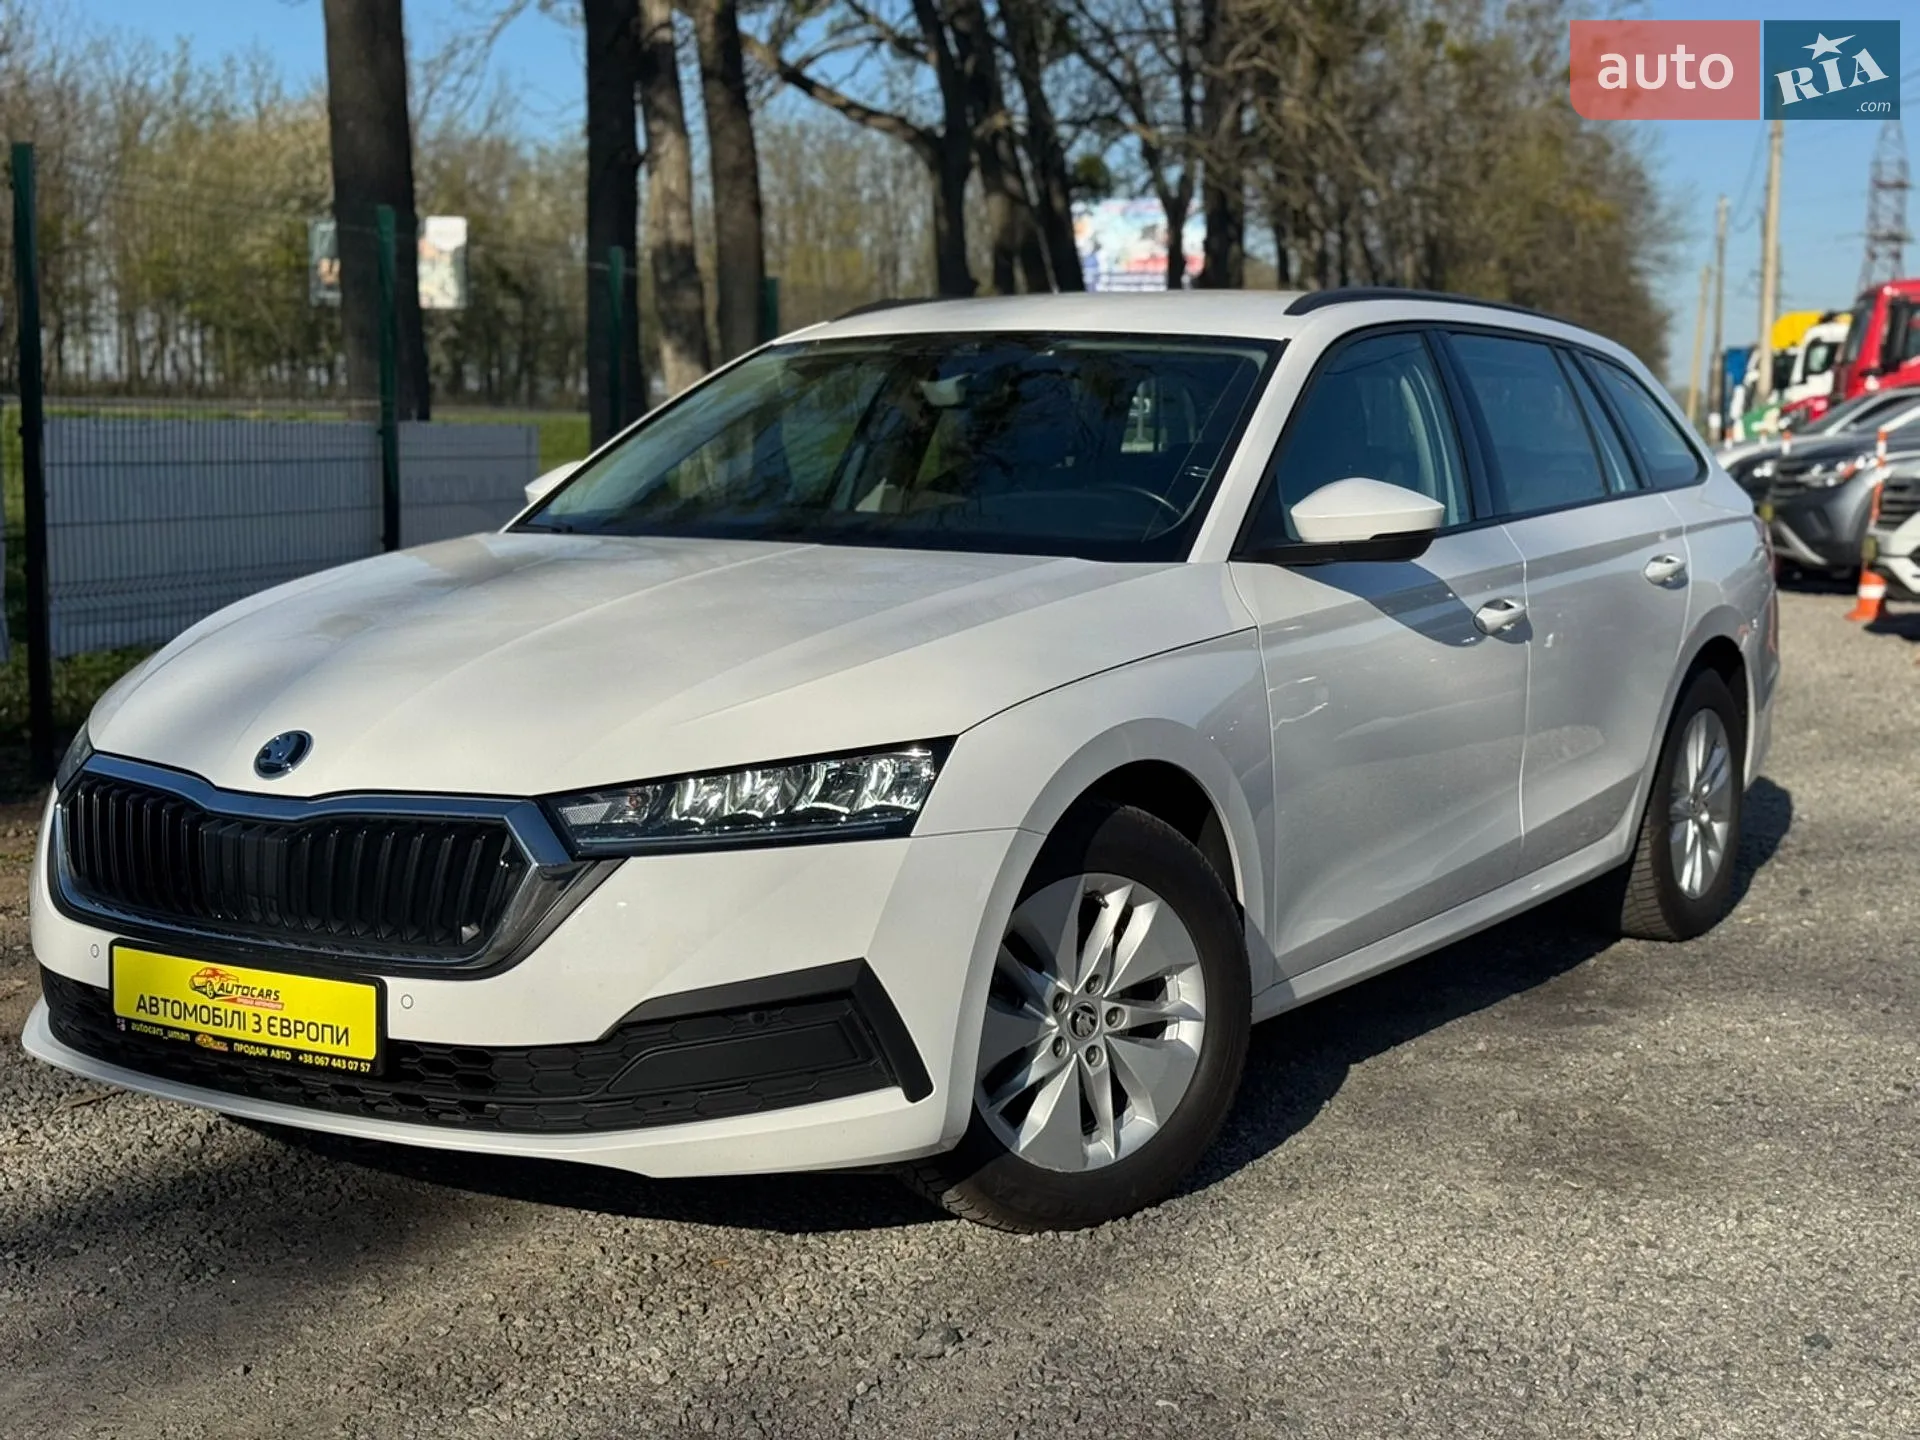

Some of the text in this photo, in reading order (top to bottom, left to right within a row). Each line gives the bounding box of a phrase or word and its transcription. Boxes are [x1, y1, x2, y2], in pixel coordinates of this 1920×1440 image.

[217, 982, 280, 1001] AUTOCARS
[136, 994, 248, 1033] АВТОМОБІЛІ
[251, 1013, 263, 1034] З
[267, 1016, 350, 1048] ЄВРОПИ
[131, 1022, 191, 1042] autocars_uman
[233, 1042, 268, 1057] ПРОДАЖ
[270, 1048, 292, 1061] АВТО
[298, 1053, 313, 1065] +38
[314, 1055, 330, 1067] 067
[347, 1060, 359, 1071] 07
[360, 1062, 371, 1073] 57
